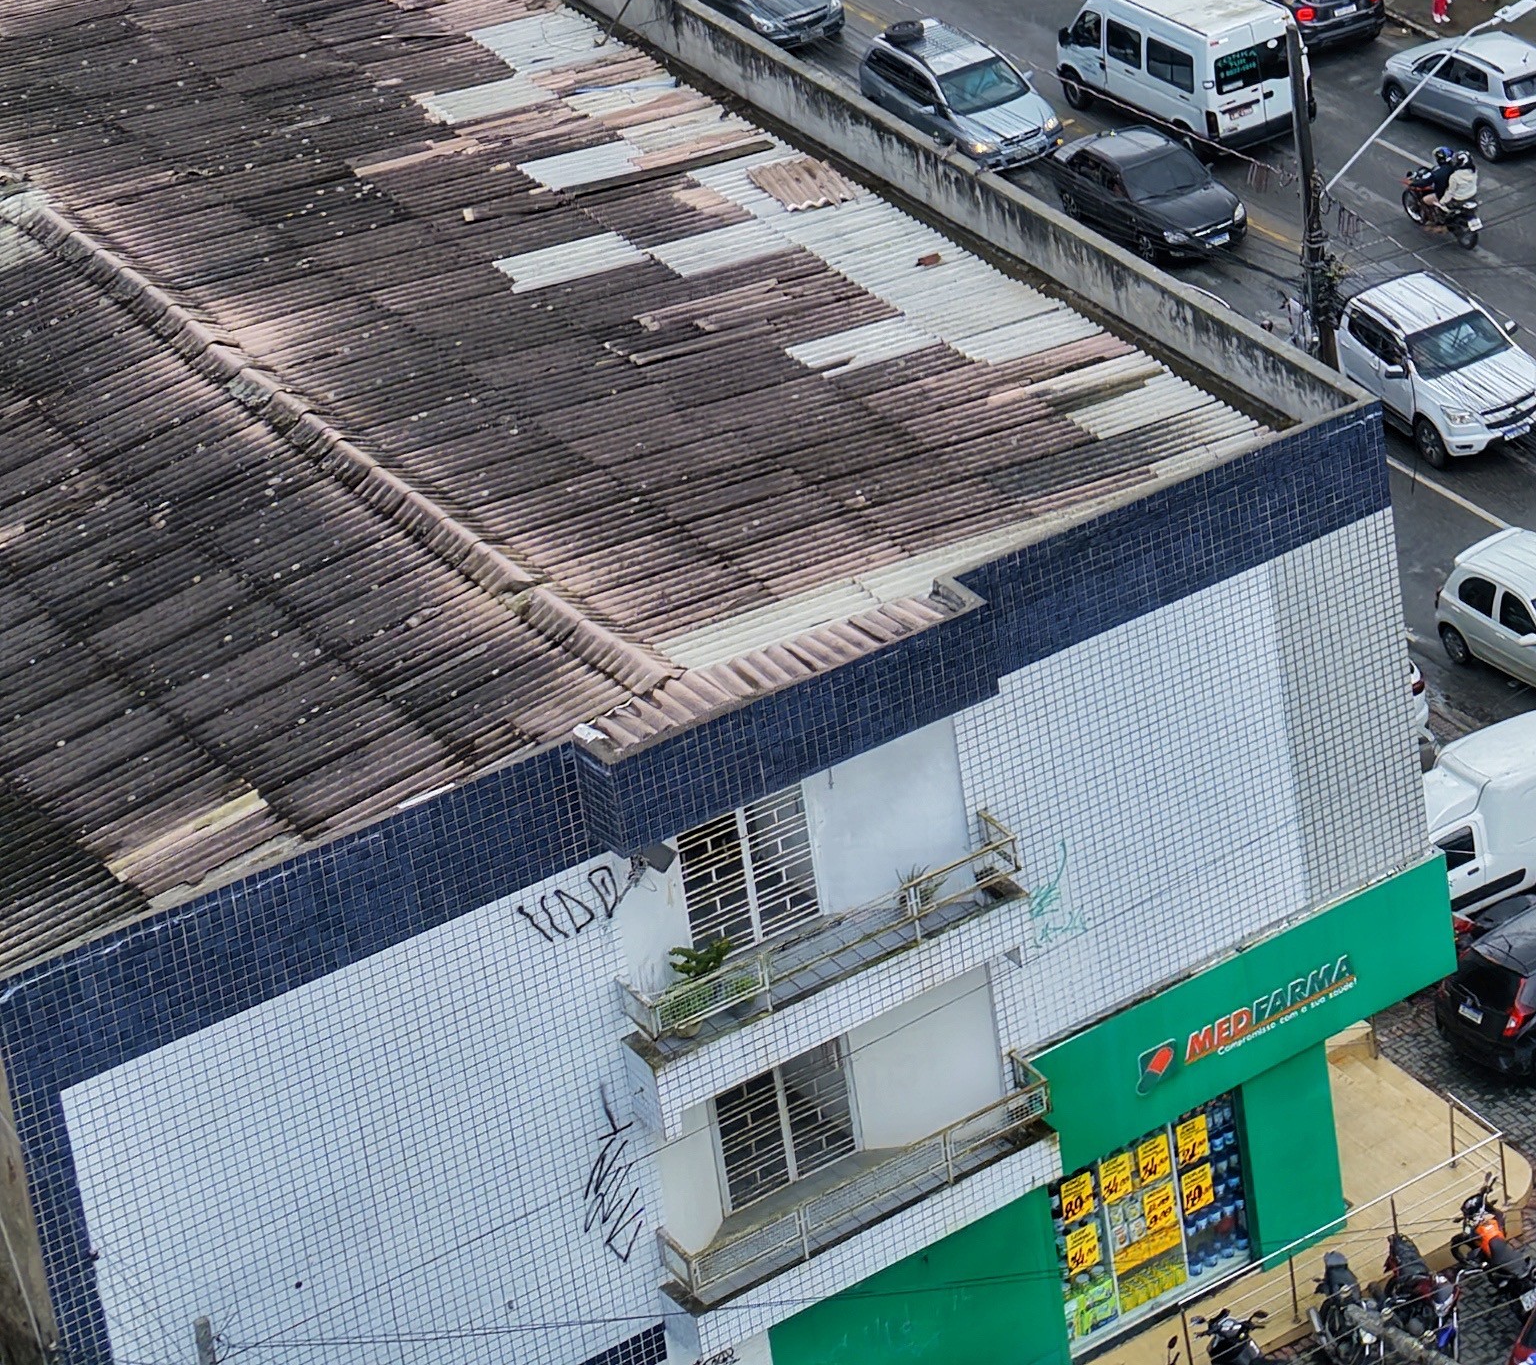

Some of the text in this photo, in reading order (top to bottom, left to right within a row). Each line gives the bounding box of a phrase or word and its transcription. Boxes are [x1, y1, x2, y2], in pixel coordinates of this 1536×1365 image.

[1186, 955, 1352, 1062] MEDFARMA
[1217, 1017, 1279, 1057] Compromisso
[1279, 1010, 1299, 1029] com
[1310, 998, 1327, 1015] sua
